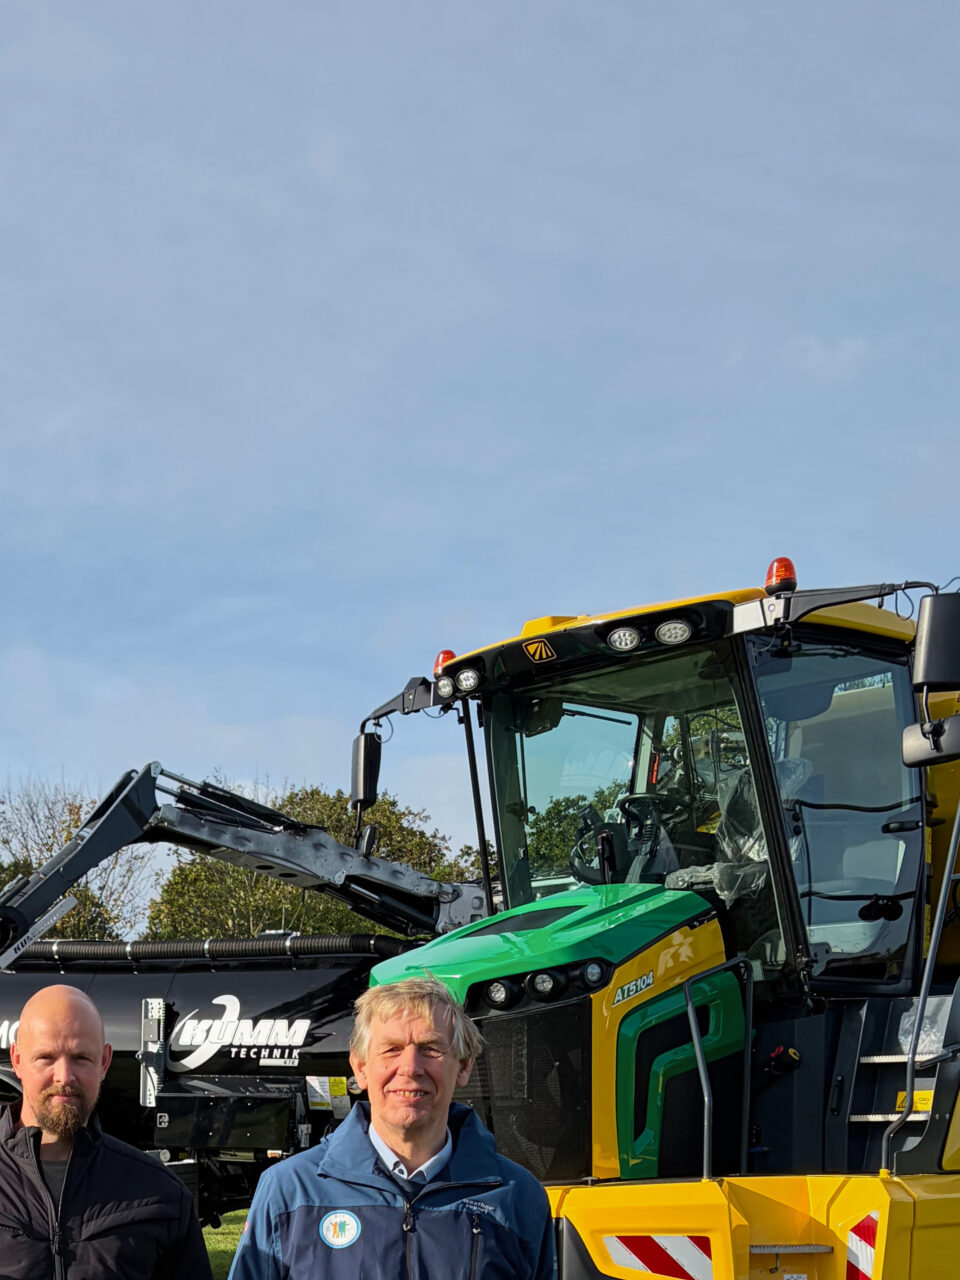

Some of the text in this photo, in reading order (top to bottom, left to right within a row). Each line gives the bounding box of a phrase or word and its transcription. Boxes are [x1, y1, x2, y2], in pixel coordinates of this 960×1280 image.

[613, 969, 654, 1004] AT5104
[178, 1018, 311, 1046] KUMM
[230, 1047, 301, 1060] TECHNIK
